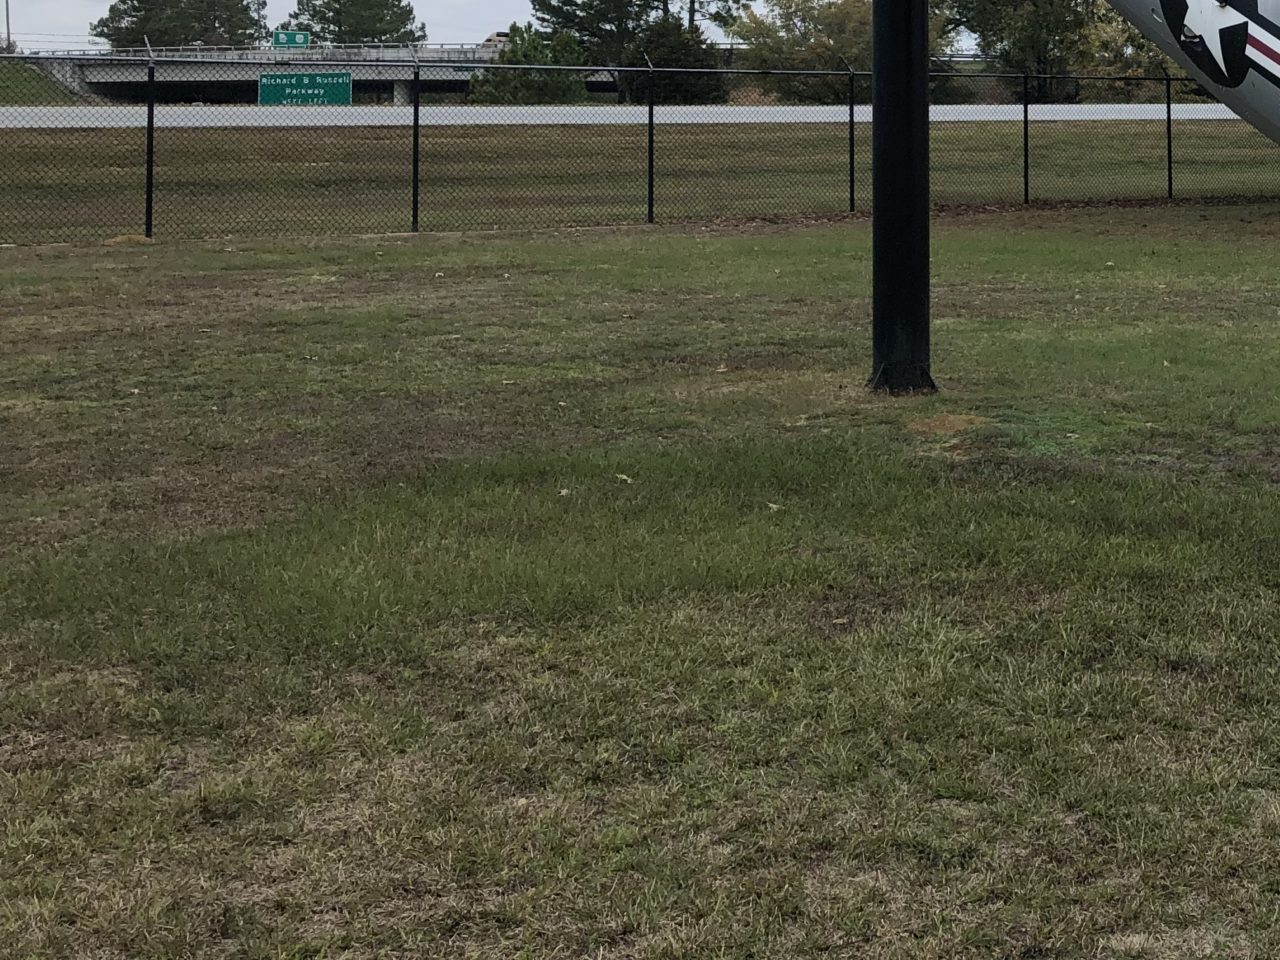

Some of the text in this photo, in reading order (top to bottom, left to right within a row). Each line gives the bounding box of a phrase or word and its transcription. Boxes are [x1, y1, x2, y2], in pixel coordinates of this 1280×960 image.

[261, 76, 297, 85] Richard
[316, 76, 349, 84] Russell
[285, 88, 325, 96] Parkway
